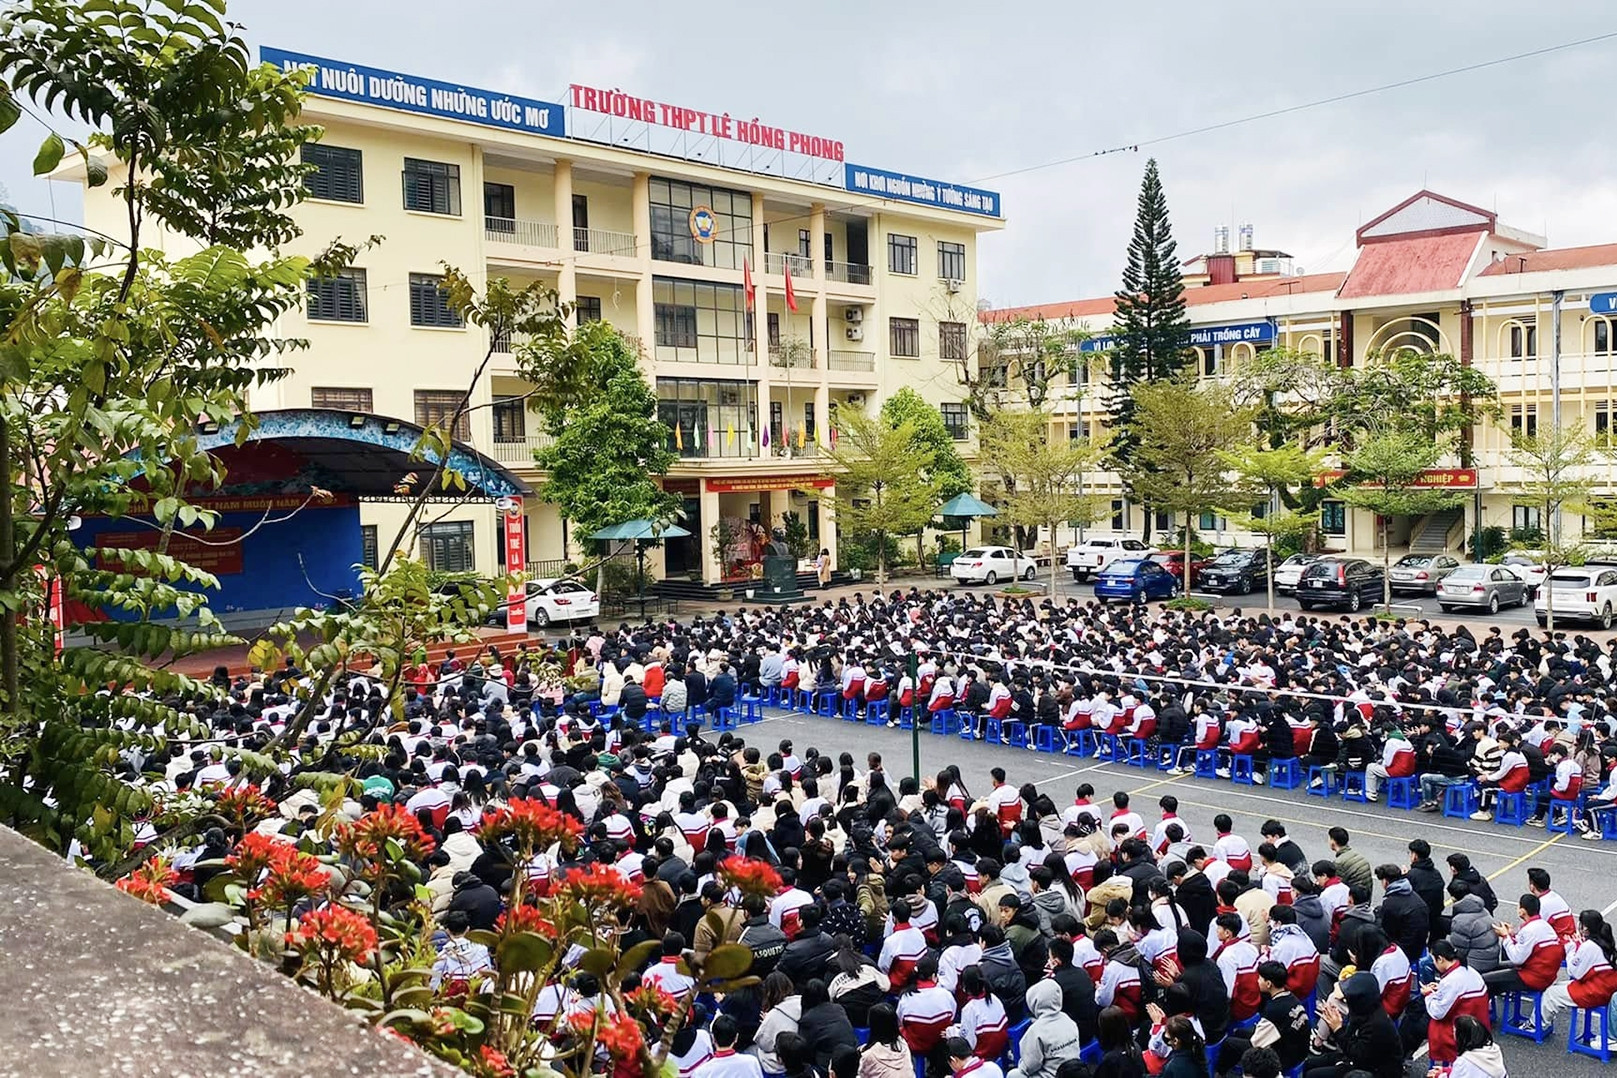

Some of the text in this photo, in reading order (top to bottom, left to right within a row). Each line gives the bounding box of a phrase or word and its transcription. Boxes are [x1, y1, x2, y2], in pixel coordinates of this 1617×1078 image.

[321, 67, 365, 96] NUÔI
[369, 76, 427, 107] DƯỠNG
[431, 88, 487, 118] NHỮNG
[491, 97, 521, 124] ƯỚC
[525, 106, 549, 129] MƠ
[570, 83, 844, 163] TRƯỜNG THPT LÊ HỒNG PHONG
[1190, 329, 1211, 343] PHẢI
